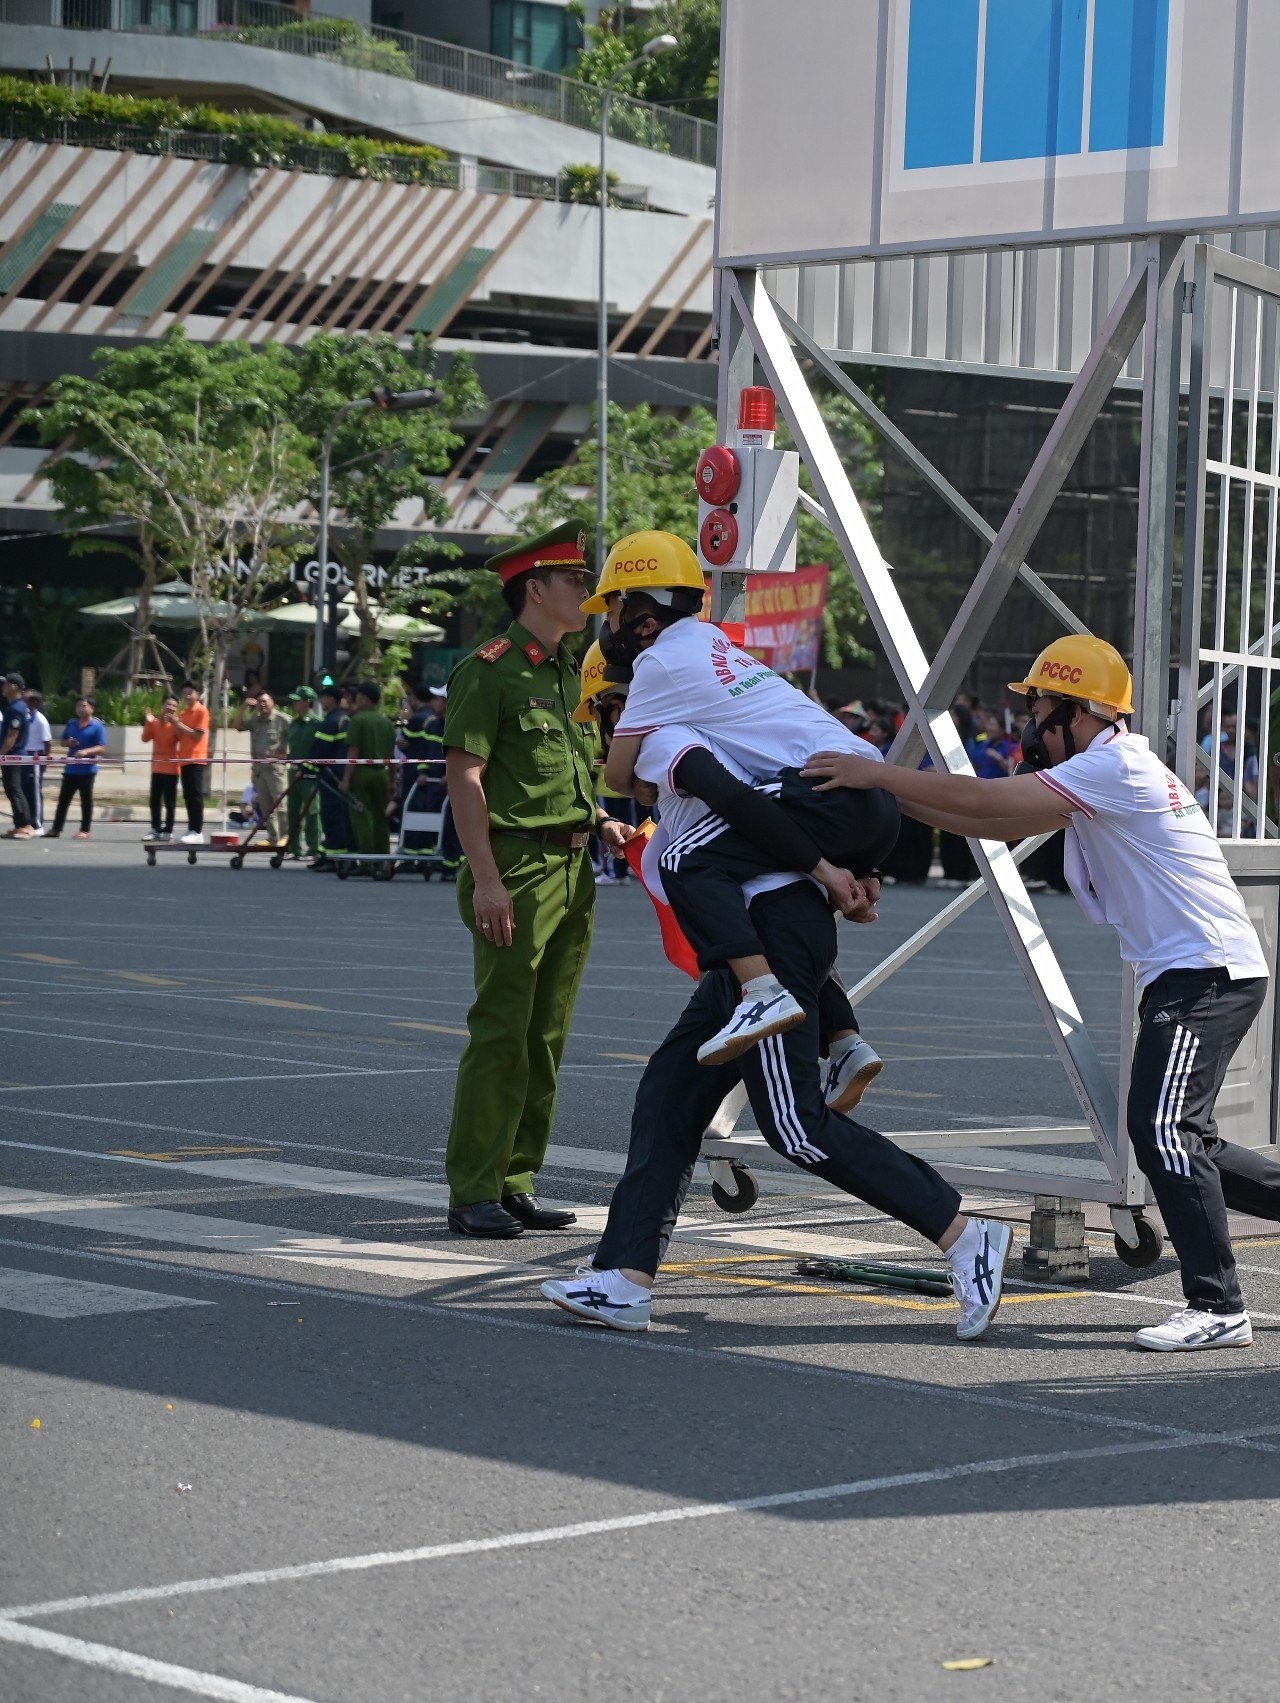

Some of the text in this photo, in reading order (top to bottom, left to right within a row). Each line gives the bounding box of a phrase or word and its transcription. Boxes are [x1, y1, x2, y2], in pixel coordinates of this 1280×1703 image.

[614, 558, 658, 574] PCCC
[711, 653, 736, 686] UBND
[1039, 661, 1083, 684] PCCC
[728, 688, 744, 697] An
